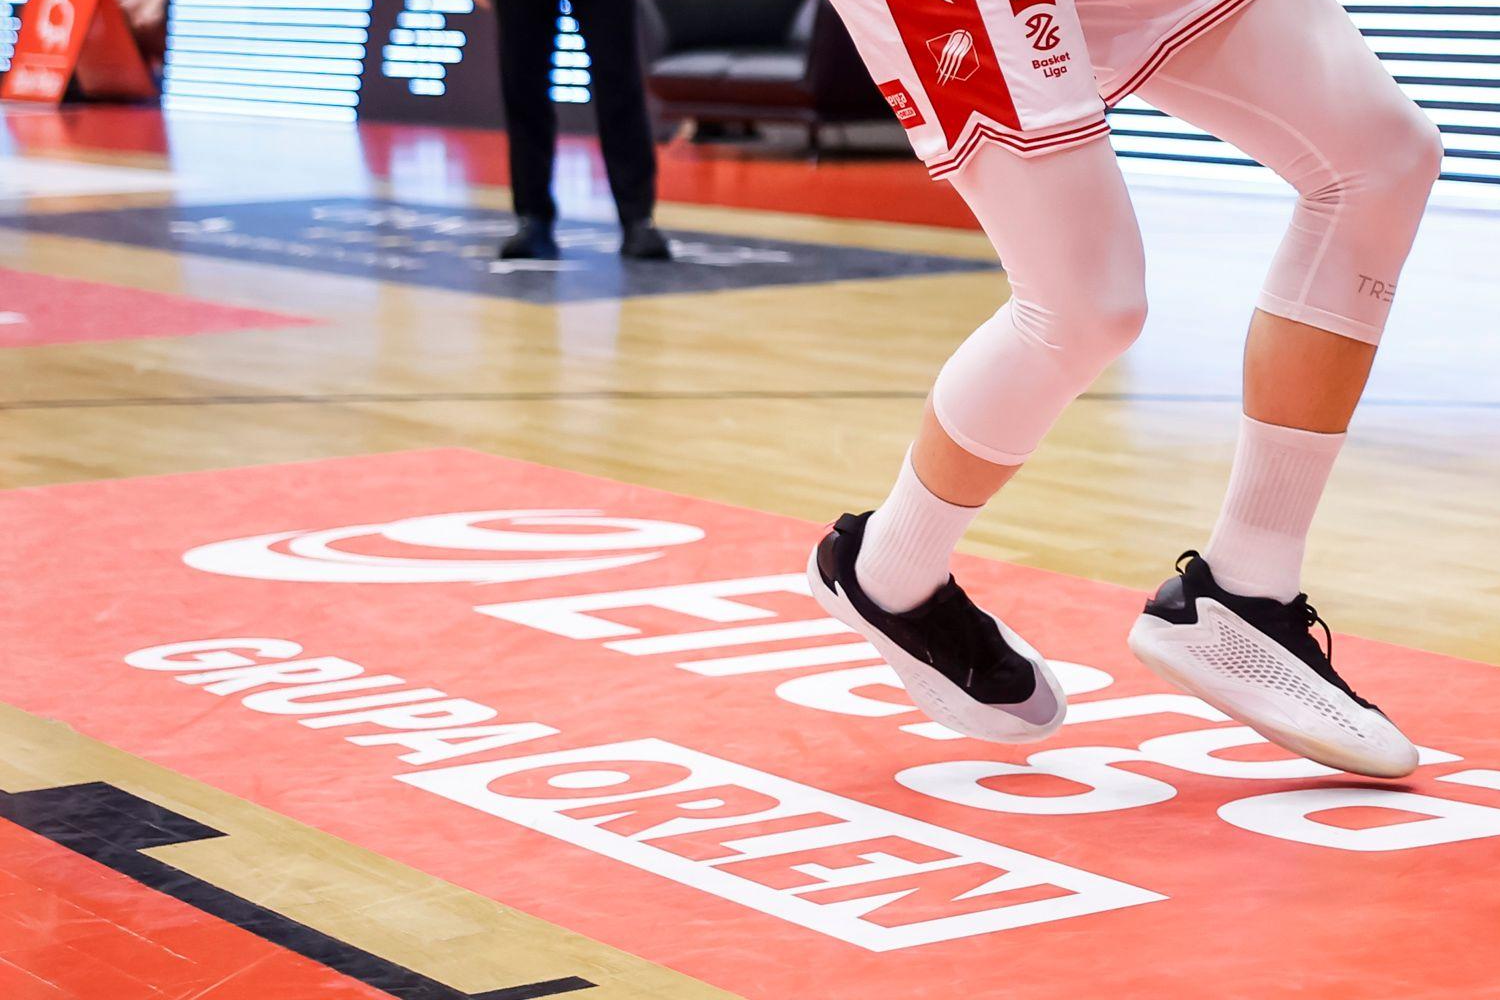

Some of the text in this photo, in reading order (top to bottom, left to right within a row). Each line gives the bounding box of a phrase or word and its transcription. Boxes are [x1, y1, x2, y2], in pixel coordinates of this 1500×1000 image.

[1031, 52, 1071, 70] Basket
[1043, 64, 1068, 79] Liga
[123, 636, 563, 766] GRUPA
[485, 759, 1082, 930] ORLEN
